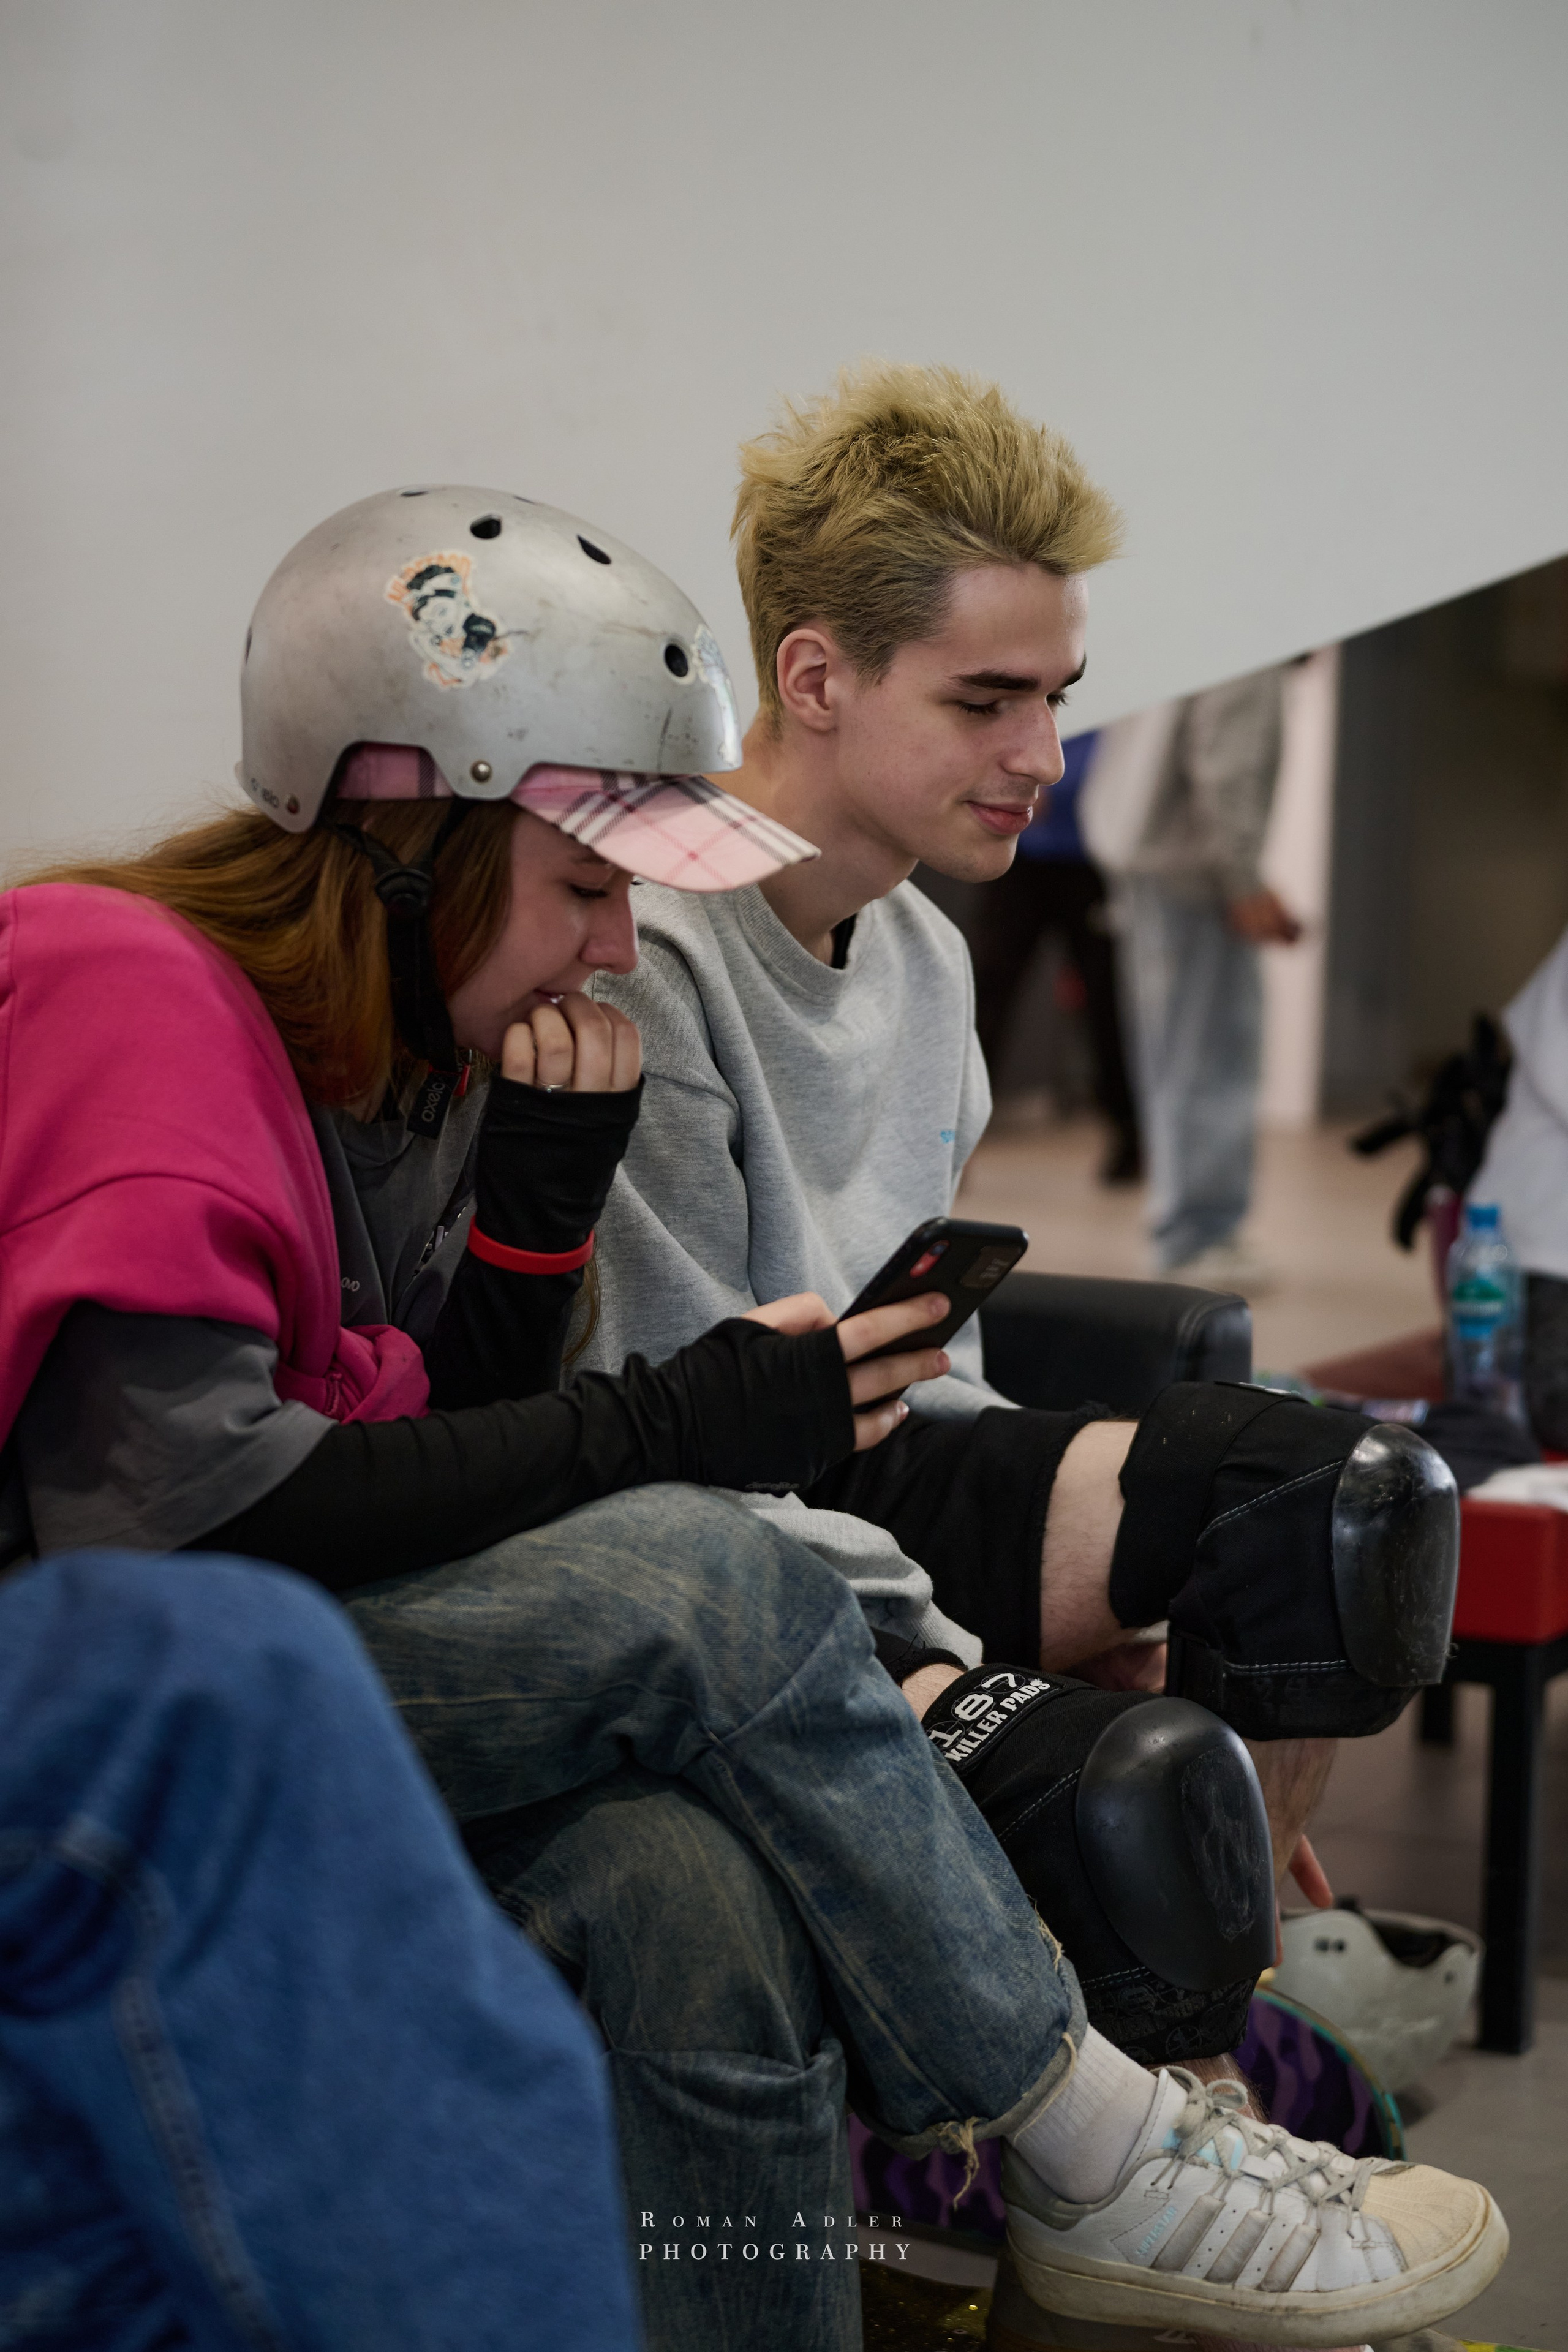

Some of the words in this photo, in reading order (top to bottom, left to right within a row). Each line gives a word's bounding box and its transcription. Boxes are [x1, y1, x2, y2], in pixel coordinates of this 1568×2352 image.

[421, 1082, 445, 1123] oxelo
[929, 1673, 1017, 1747] 187
[944, 1710, 1008, 1762] KILLER
[1000, 1678, 1050, 1711] PADS
